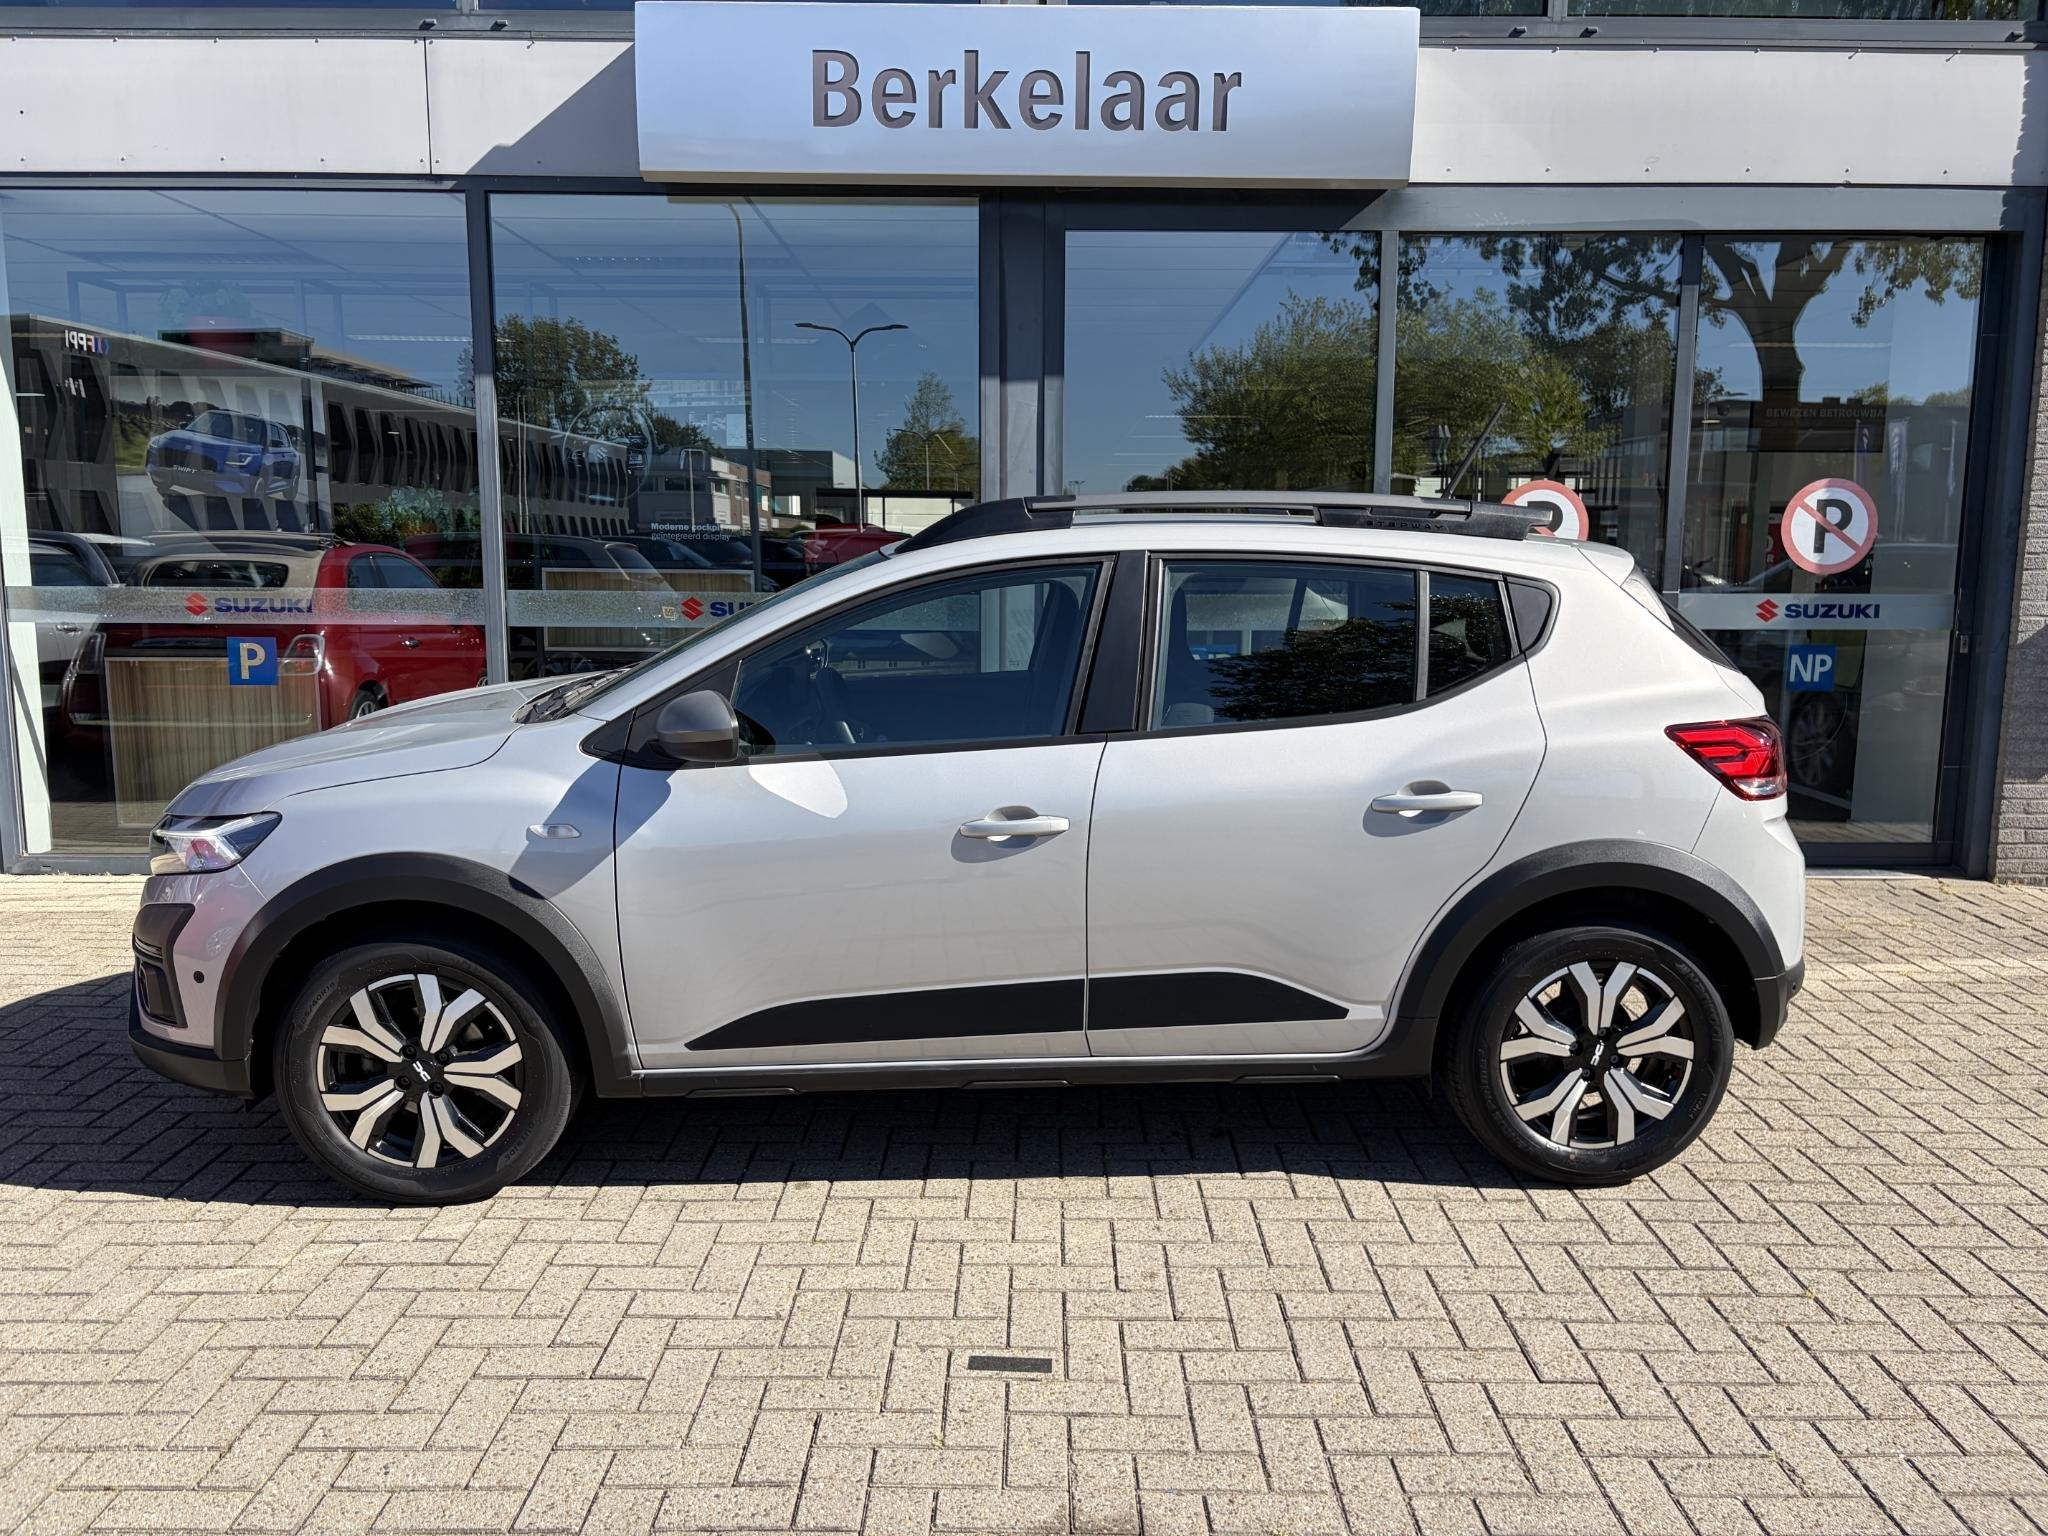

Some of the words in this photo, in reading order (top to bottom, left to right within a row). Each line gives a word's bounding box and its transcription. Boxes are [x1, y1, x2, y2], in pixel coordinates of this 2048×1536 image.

[812, 49, 1242, 131] Berkelaar
[651, 522, 689, 531] Moderne
[703, 533, 731, 542] display
[214, 597, 313, 613] SUZUKI
[1784, 603, 1881, 619] SUZUKI
[239, 642, 266, 680] P
[1789, 653, 1833, 683] NP
